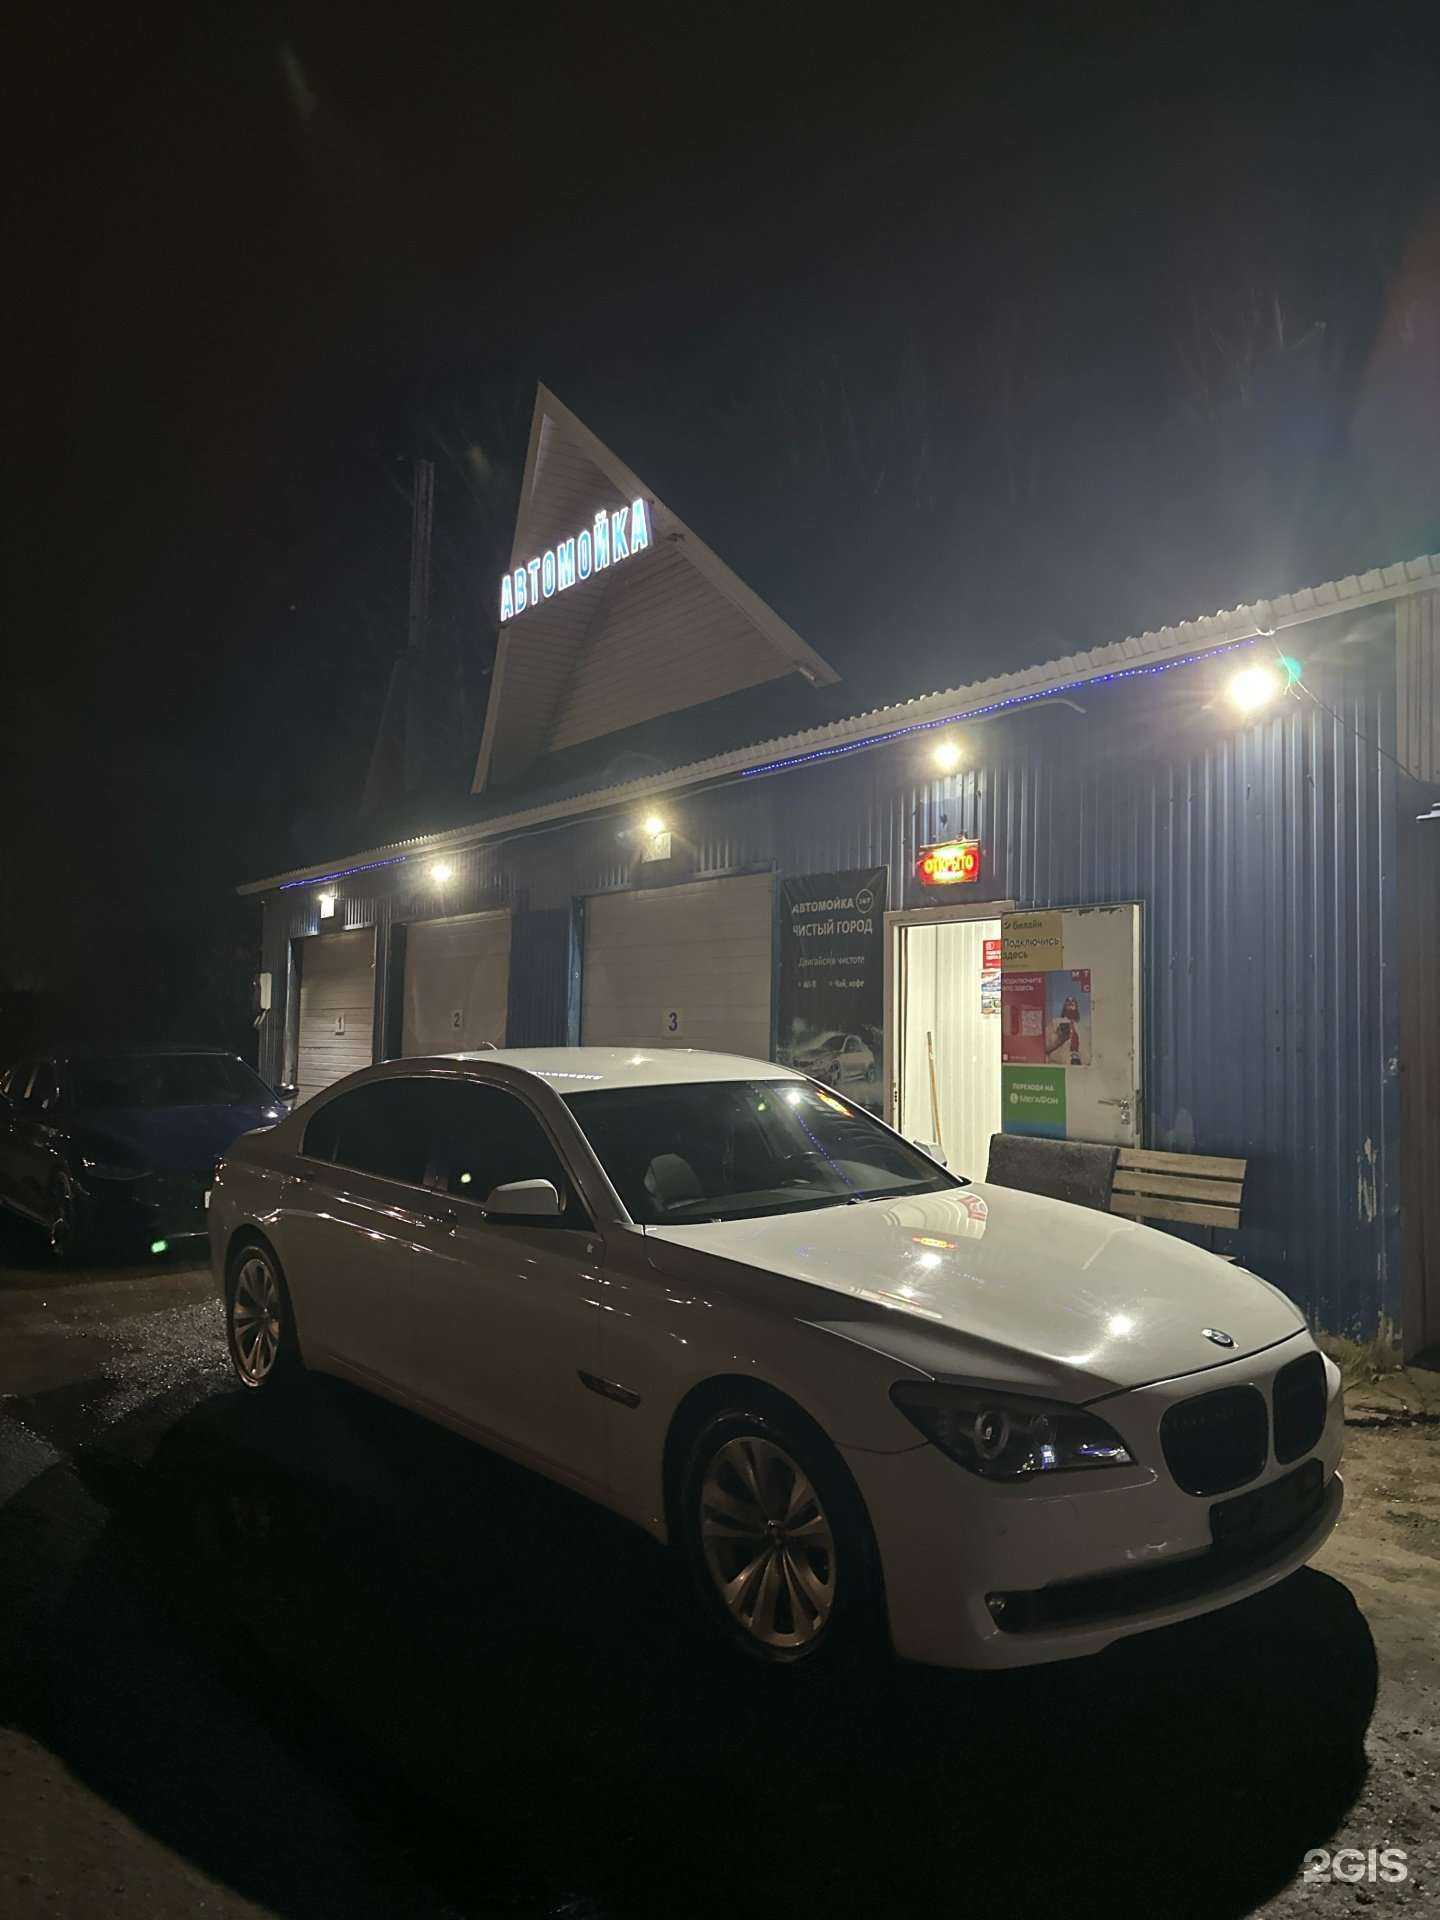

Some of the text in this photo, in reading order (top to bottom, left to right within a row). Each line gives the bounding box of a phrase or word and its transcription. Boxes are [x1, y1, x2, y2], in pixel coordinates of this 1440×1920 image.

[500, 498, 649, 622] АВТОМОЙКА
[924, 854, 974, 875] ОТКРЫТО
[792, 897, 855, 914] АВТОМОЙКА
[792, 918, 873, 937] ЧИСТЫЙ ГОРОД
[337, 1016, 342, 1031] 1
[453, 1011, 461, 1028] 2
[668, 1011, 678, 1032] 3
